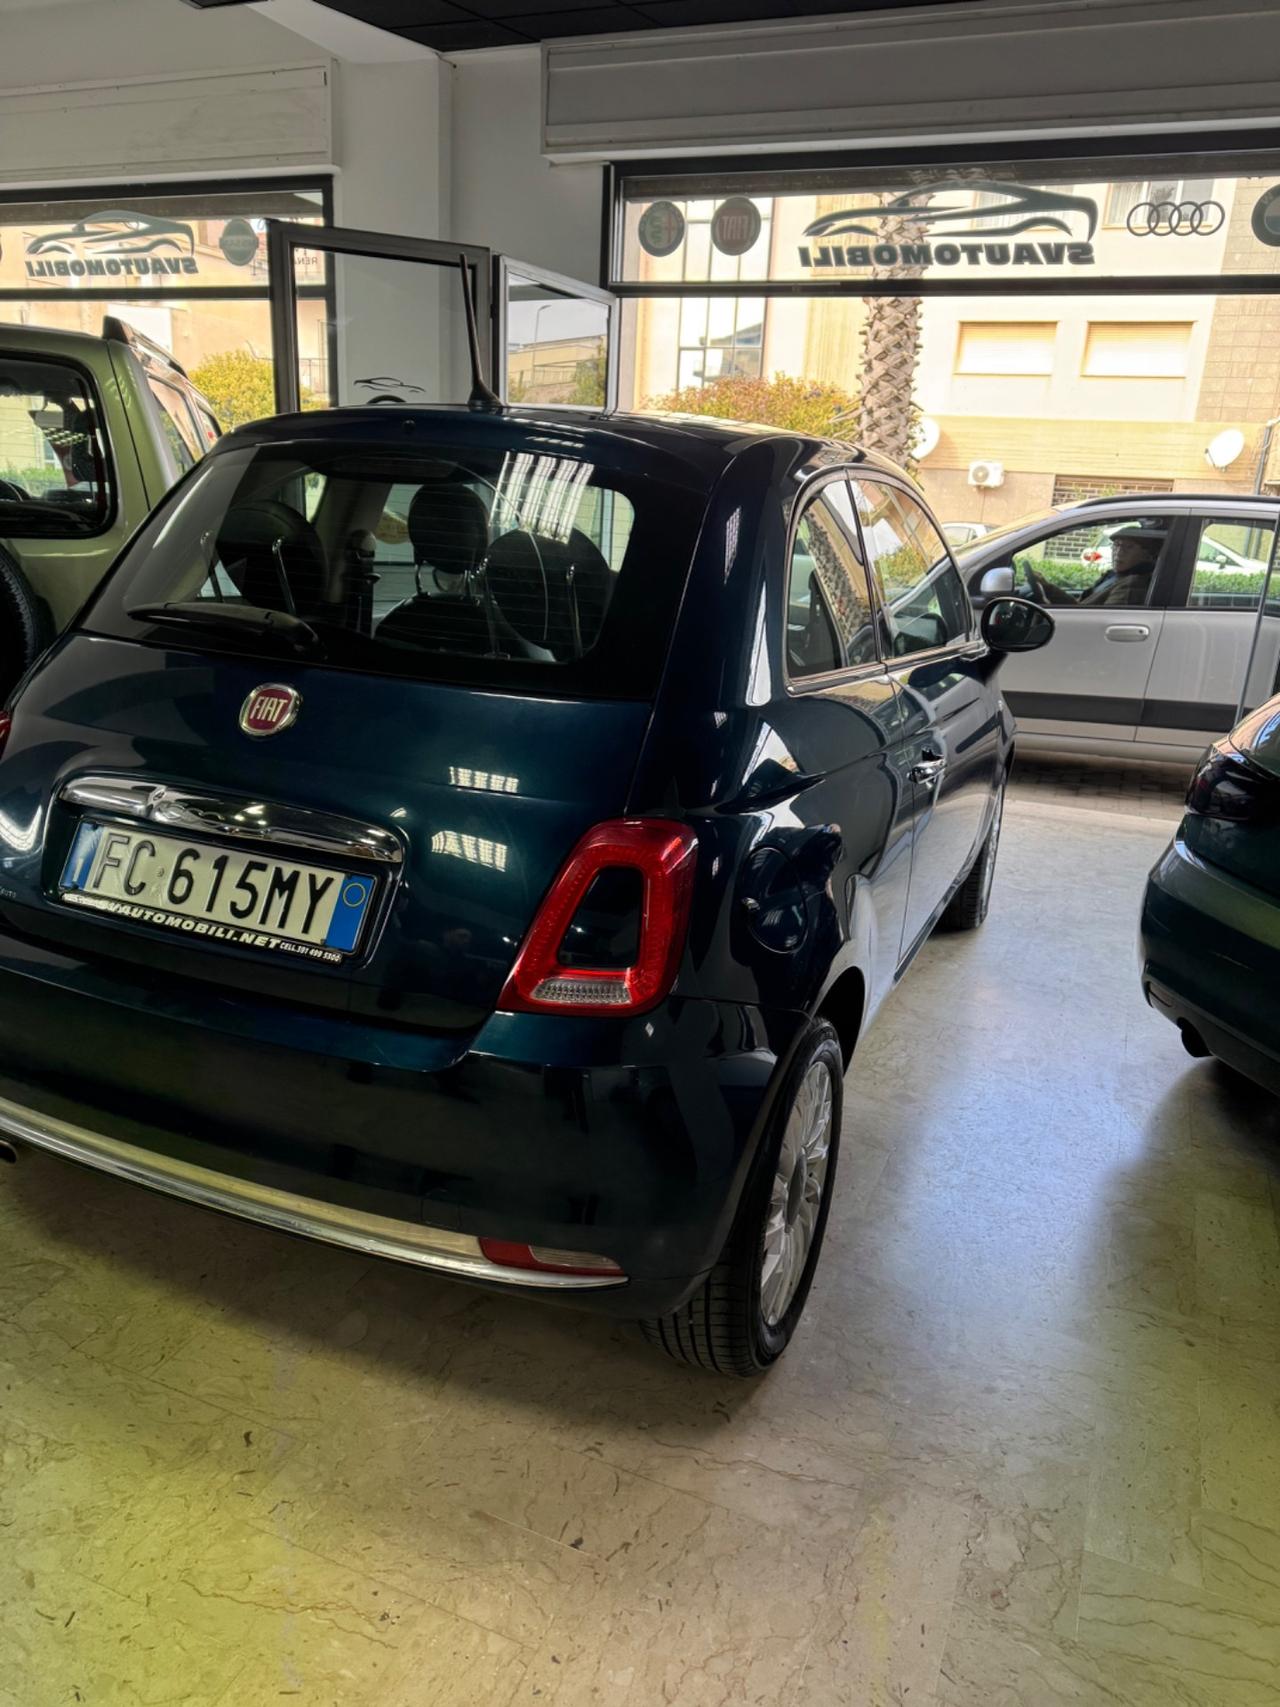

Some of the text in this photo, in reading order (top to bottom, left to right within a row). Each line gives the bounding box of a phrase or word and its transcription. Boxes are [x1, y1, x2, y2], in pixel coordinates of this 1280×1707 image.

[249, 695, 289, 722] FIAT
[92, 832, 335, 935] FC 615MY
